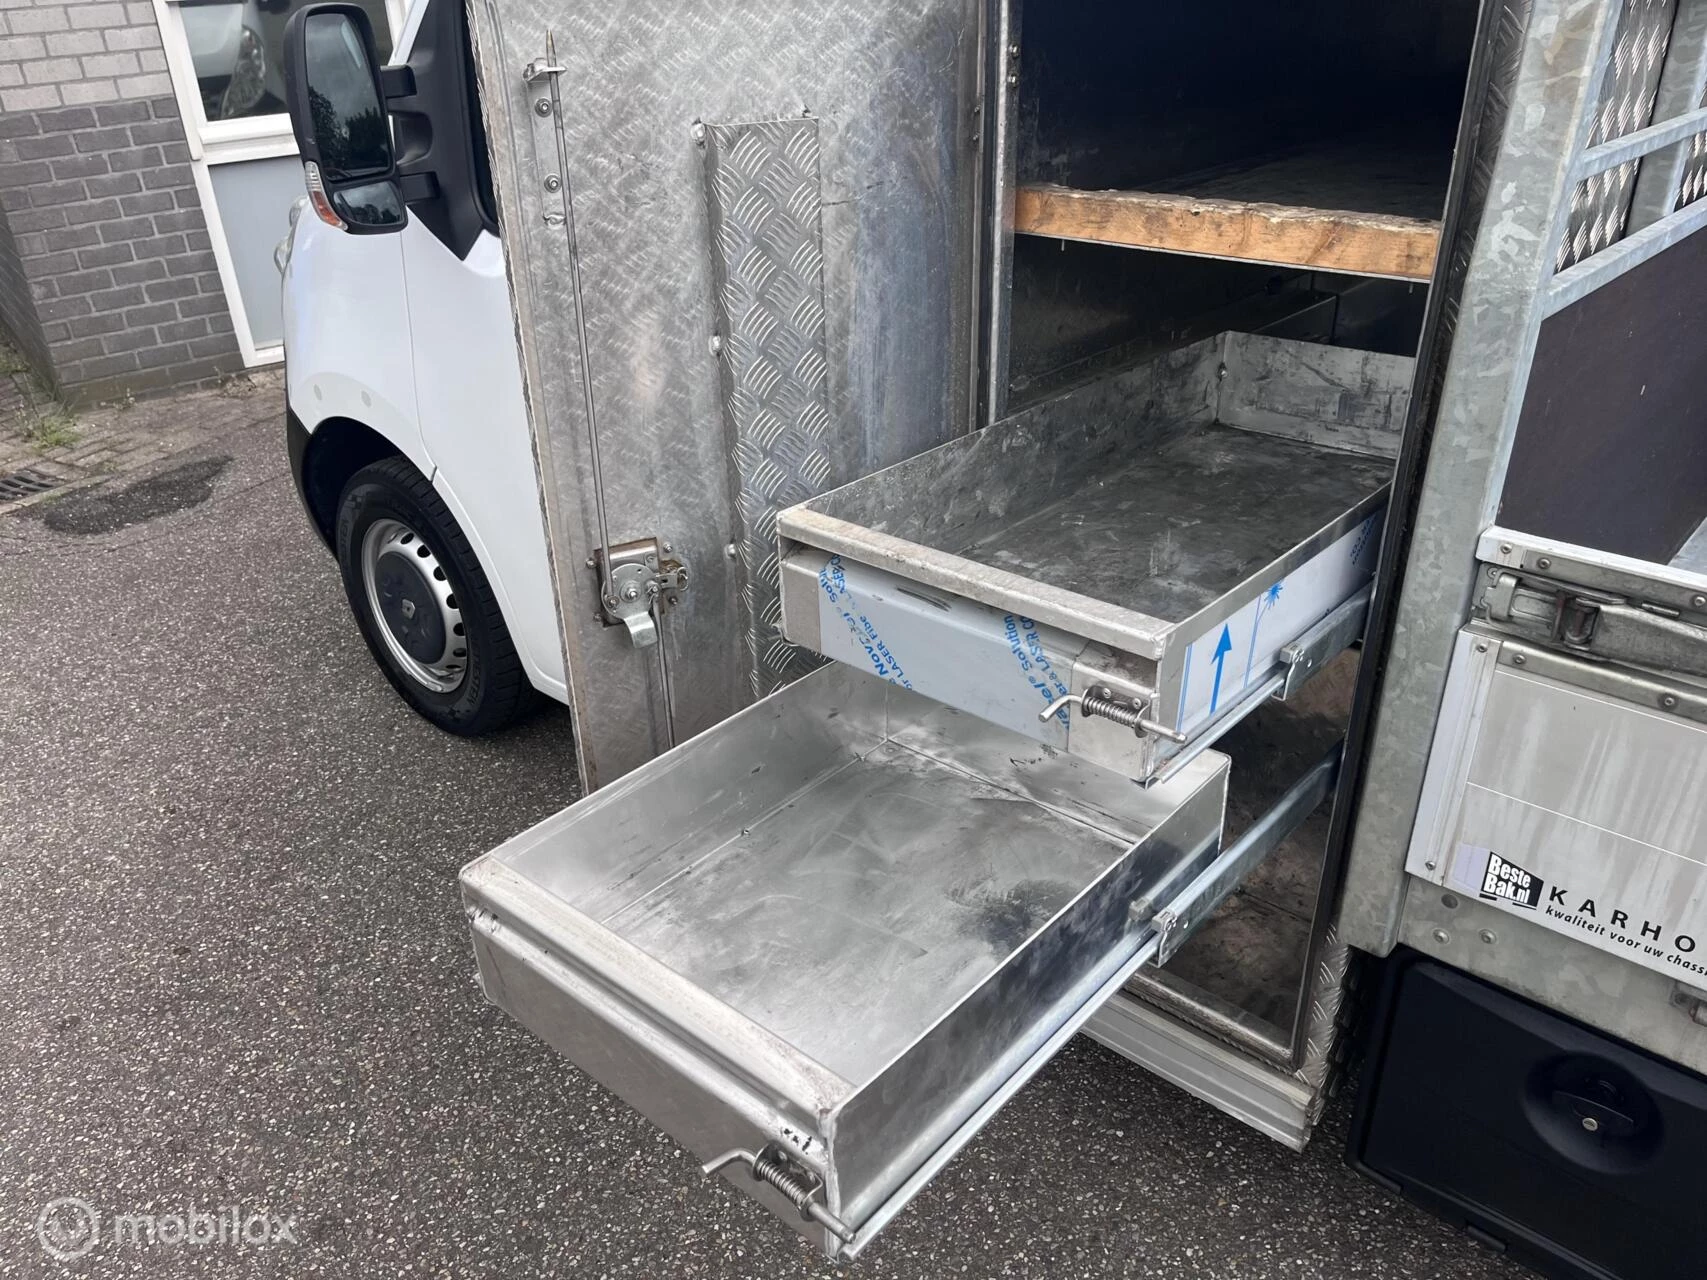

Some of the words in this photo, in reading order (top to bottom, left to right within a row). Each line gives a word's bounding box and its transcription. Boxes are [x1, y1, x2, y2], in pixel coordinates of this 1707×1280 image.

[859, 614, 878, 640] Fibe
[1004, 615, 1030, 672] Solution
[876, 640, 904, 678] LASER
[1025, 631, 1050, 672] LASER
[1483, 873, 1531, 904] Bak.nl
[1488, 853, 1532, 889] Beste
[1545, 904, 1606, 936] kwaliteit
[1609, 931, 1641, 950] voor
[1643, 945, 1664, 958] uw
[1549, 886, 1696, 953] KARHO
